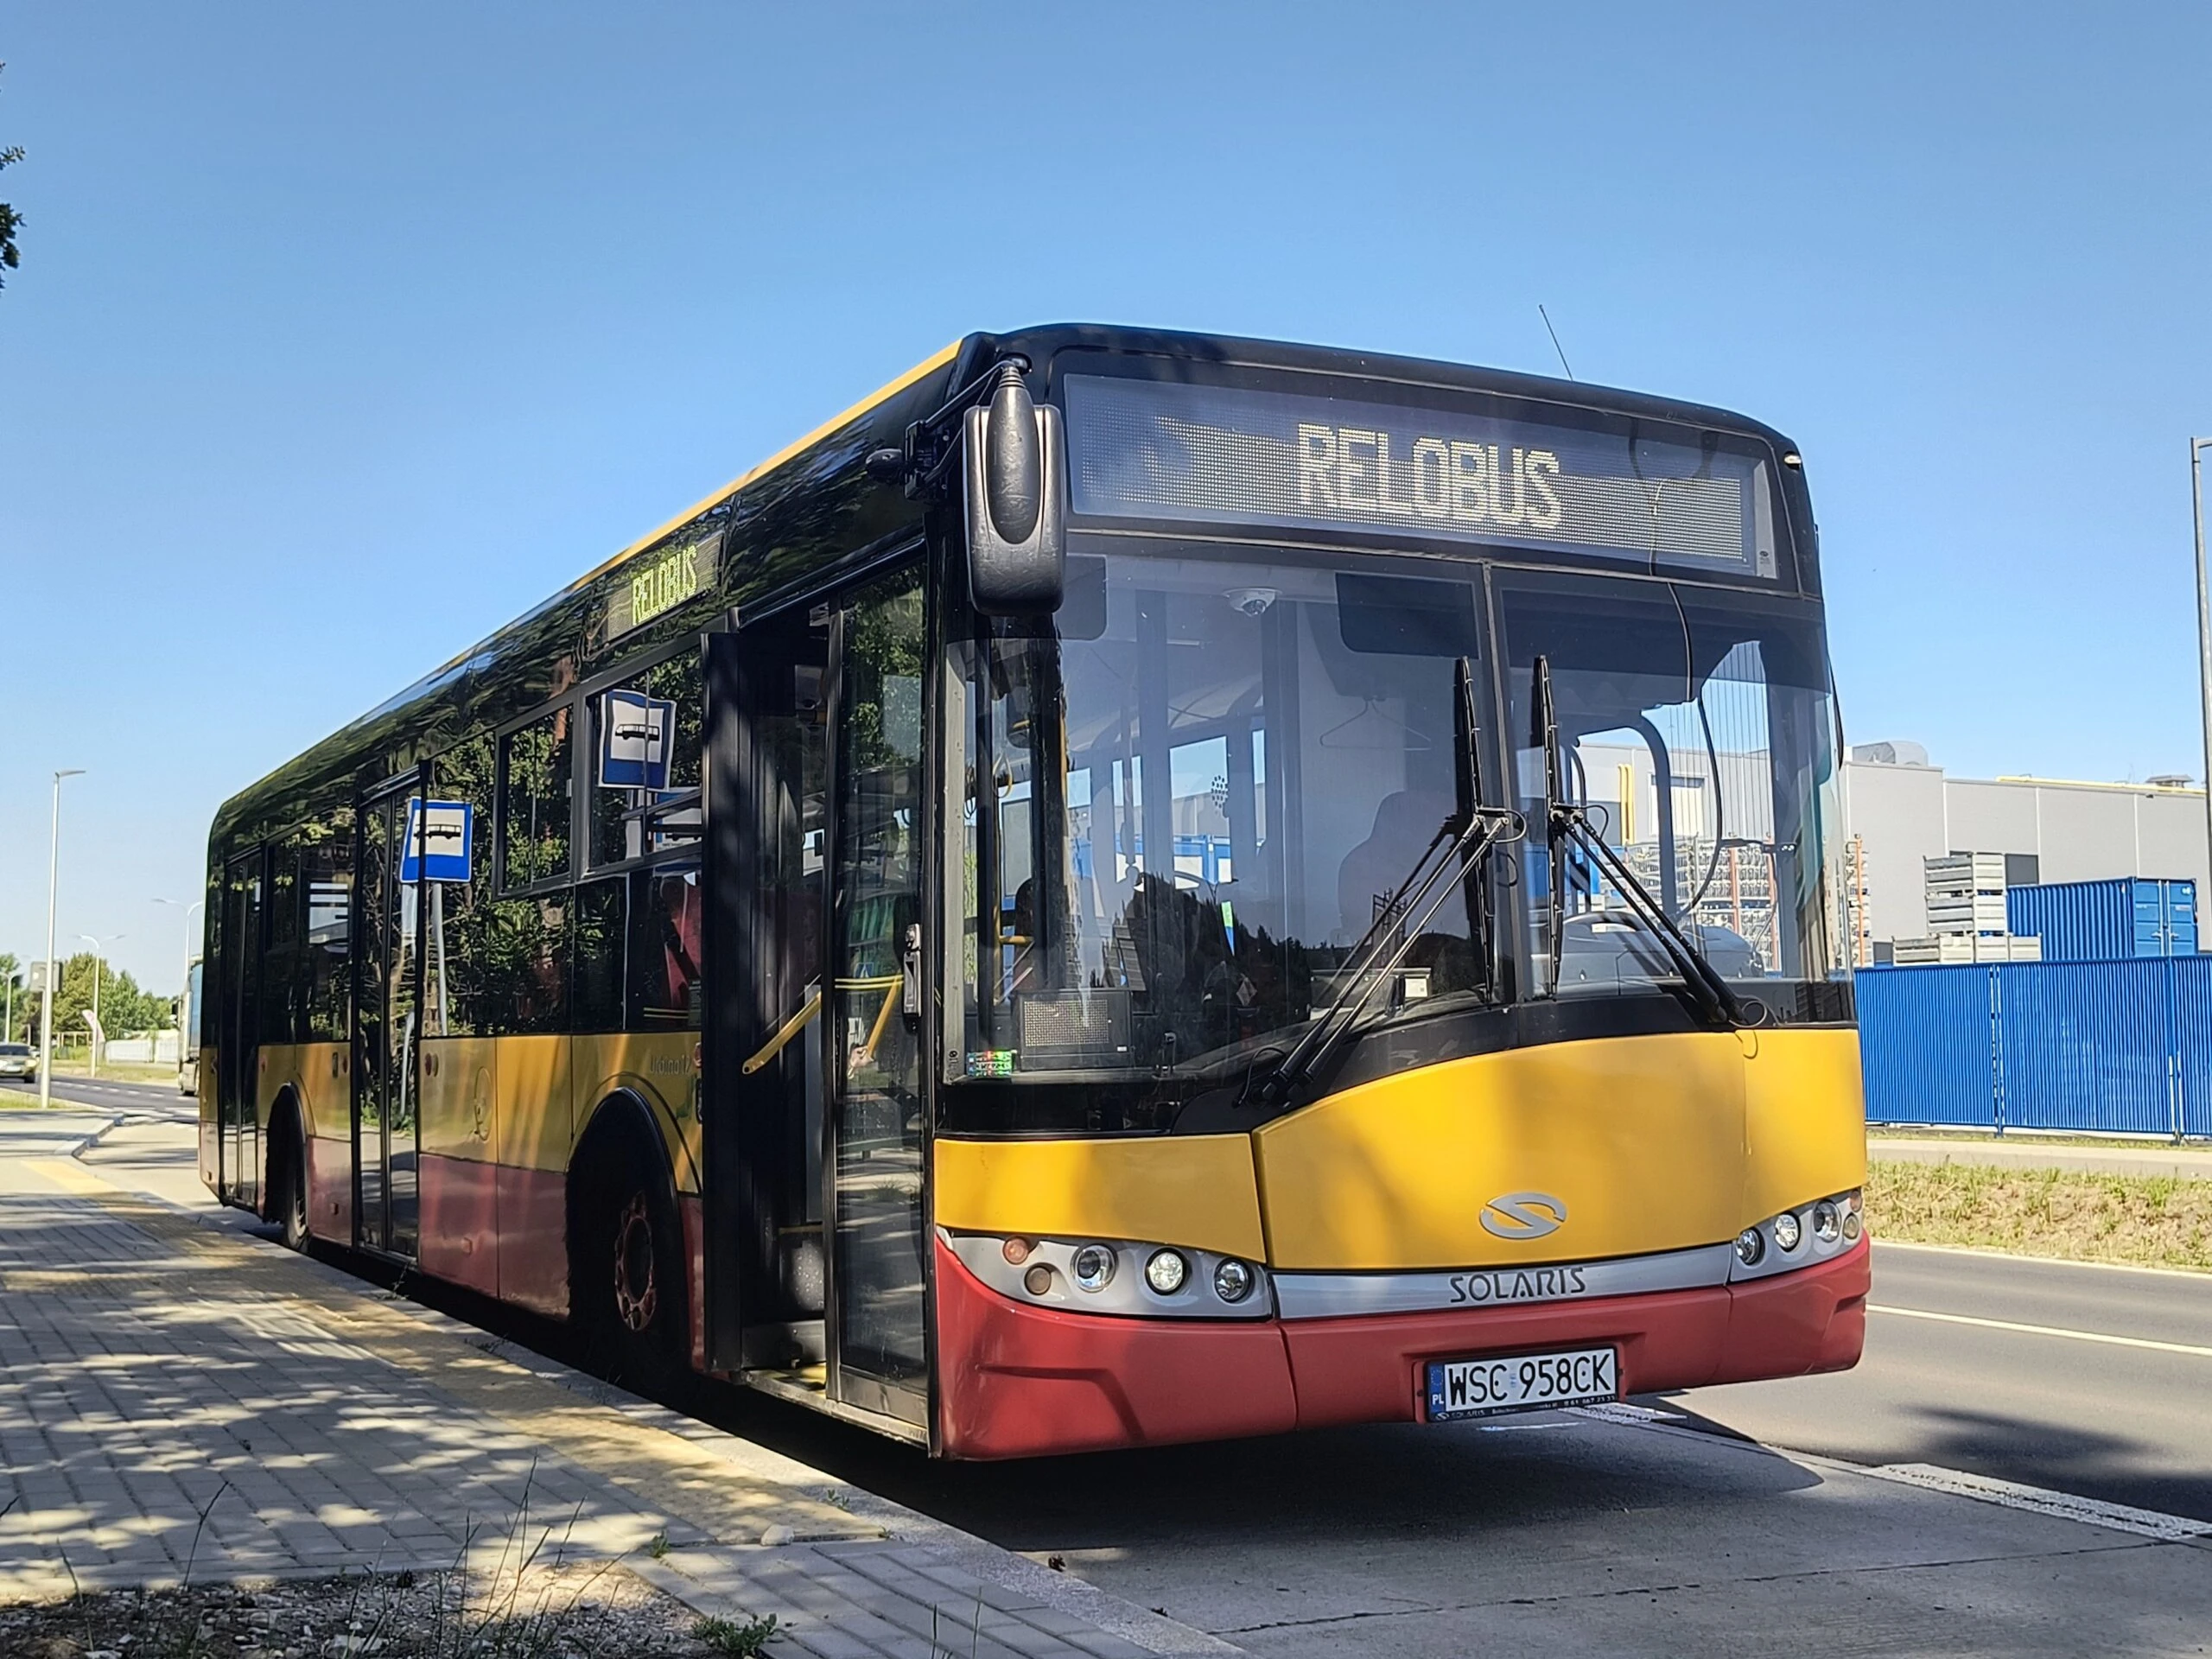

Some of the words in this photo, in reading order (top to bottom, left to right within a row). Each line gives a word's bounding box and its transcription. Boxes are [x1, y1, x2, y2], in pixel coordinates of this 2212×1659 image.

[1297, 422, 1564, 531] RELOBUS
[632, 544, 698, 626] RELOBUS
[1449, 1267, 1586, 1303] SOLARIS
[1432, 1393, 1445, 1405] PL
[1448, 1363, 1508, 1407] WSC
[1519, 1353, 1611, 1400] 958CK
